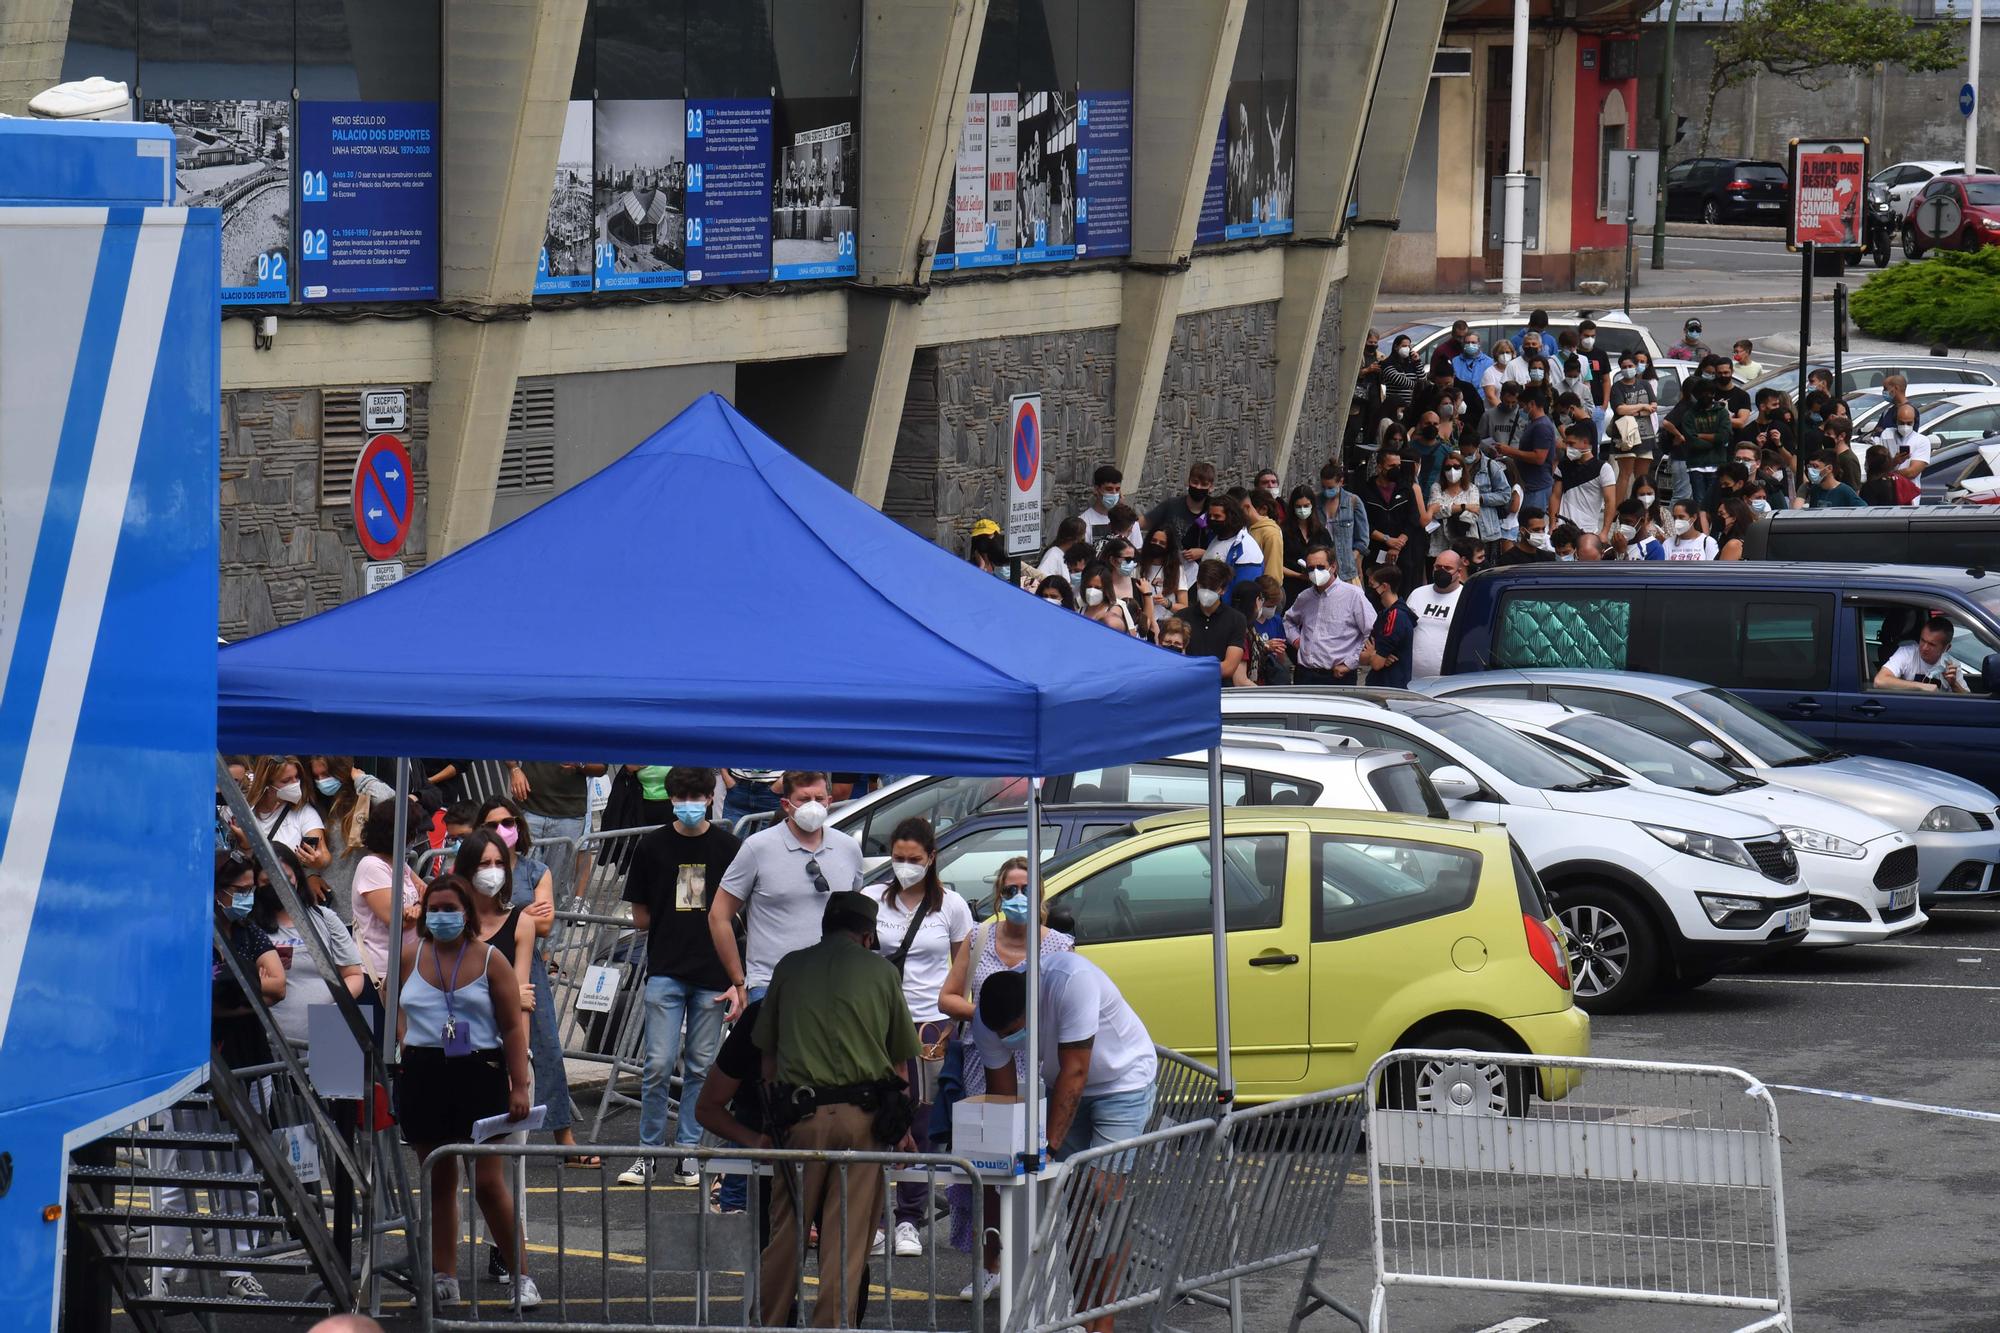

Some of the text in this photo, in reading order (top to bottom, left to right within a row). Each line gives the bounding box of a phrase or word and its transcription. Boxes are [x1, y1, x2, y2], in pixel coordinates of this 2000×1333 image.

[332, 113, 386, 125] MEDIO SÉCULO DO
[687, 109, 702, 132] 03
[1078, 100, 1088, 121] 06
[332, 129, 431, 141] PALACIO DOS DEPORTES
[332, 146, 430, 155] UNHA HISTORIA VISUAL 1970-2020
[1077, 149, 1087, 169] 07
[687, 163, 702, 187] 04
[1802, 161, 1859, 175] A RAPA DAS
[303, 170, 326, 196] 01
[989, 171, 1016, 191] MARI TRINI
[1801, 175, 1838, 188] BESTAS
[1801, 188, 1834, 201] NUNCA
[1076, 198, 1087, 218] 08
[687, 217, 701, 241] 05
[1034, 219, 1045, 242] 08
[1800, 215, 1822, 229] SOA.
[303, 229, 326, 255] 02
[838, 231, 853, 255] 05
[985, 223, 997, 246] 07
[538, 246, 546, 272] 3
[596, 242, 613, 268] 04
[258, 252, 283, 280] 02
[221, 292, 242, 300] ALACIO
[256, 290, 287, 299] DEPORTES
[368, 406, 402, 415] AMBULANCIA
[373, 396, 398, 405] EXCEPTO
[375, 566, 395, 575] EXCEPTO
[1423, 603, 1450, 618] HH
